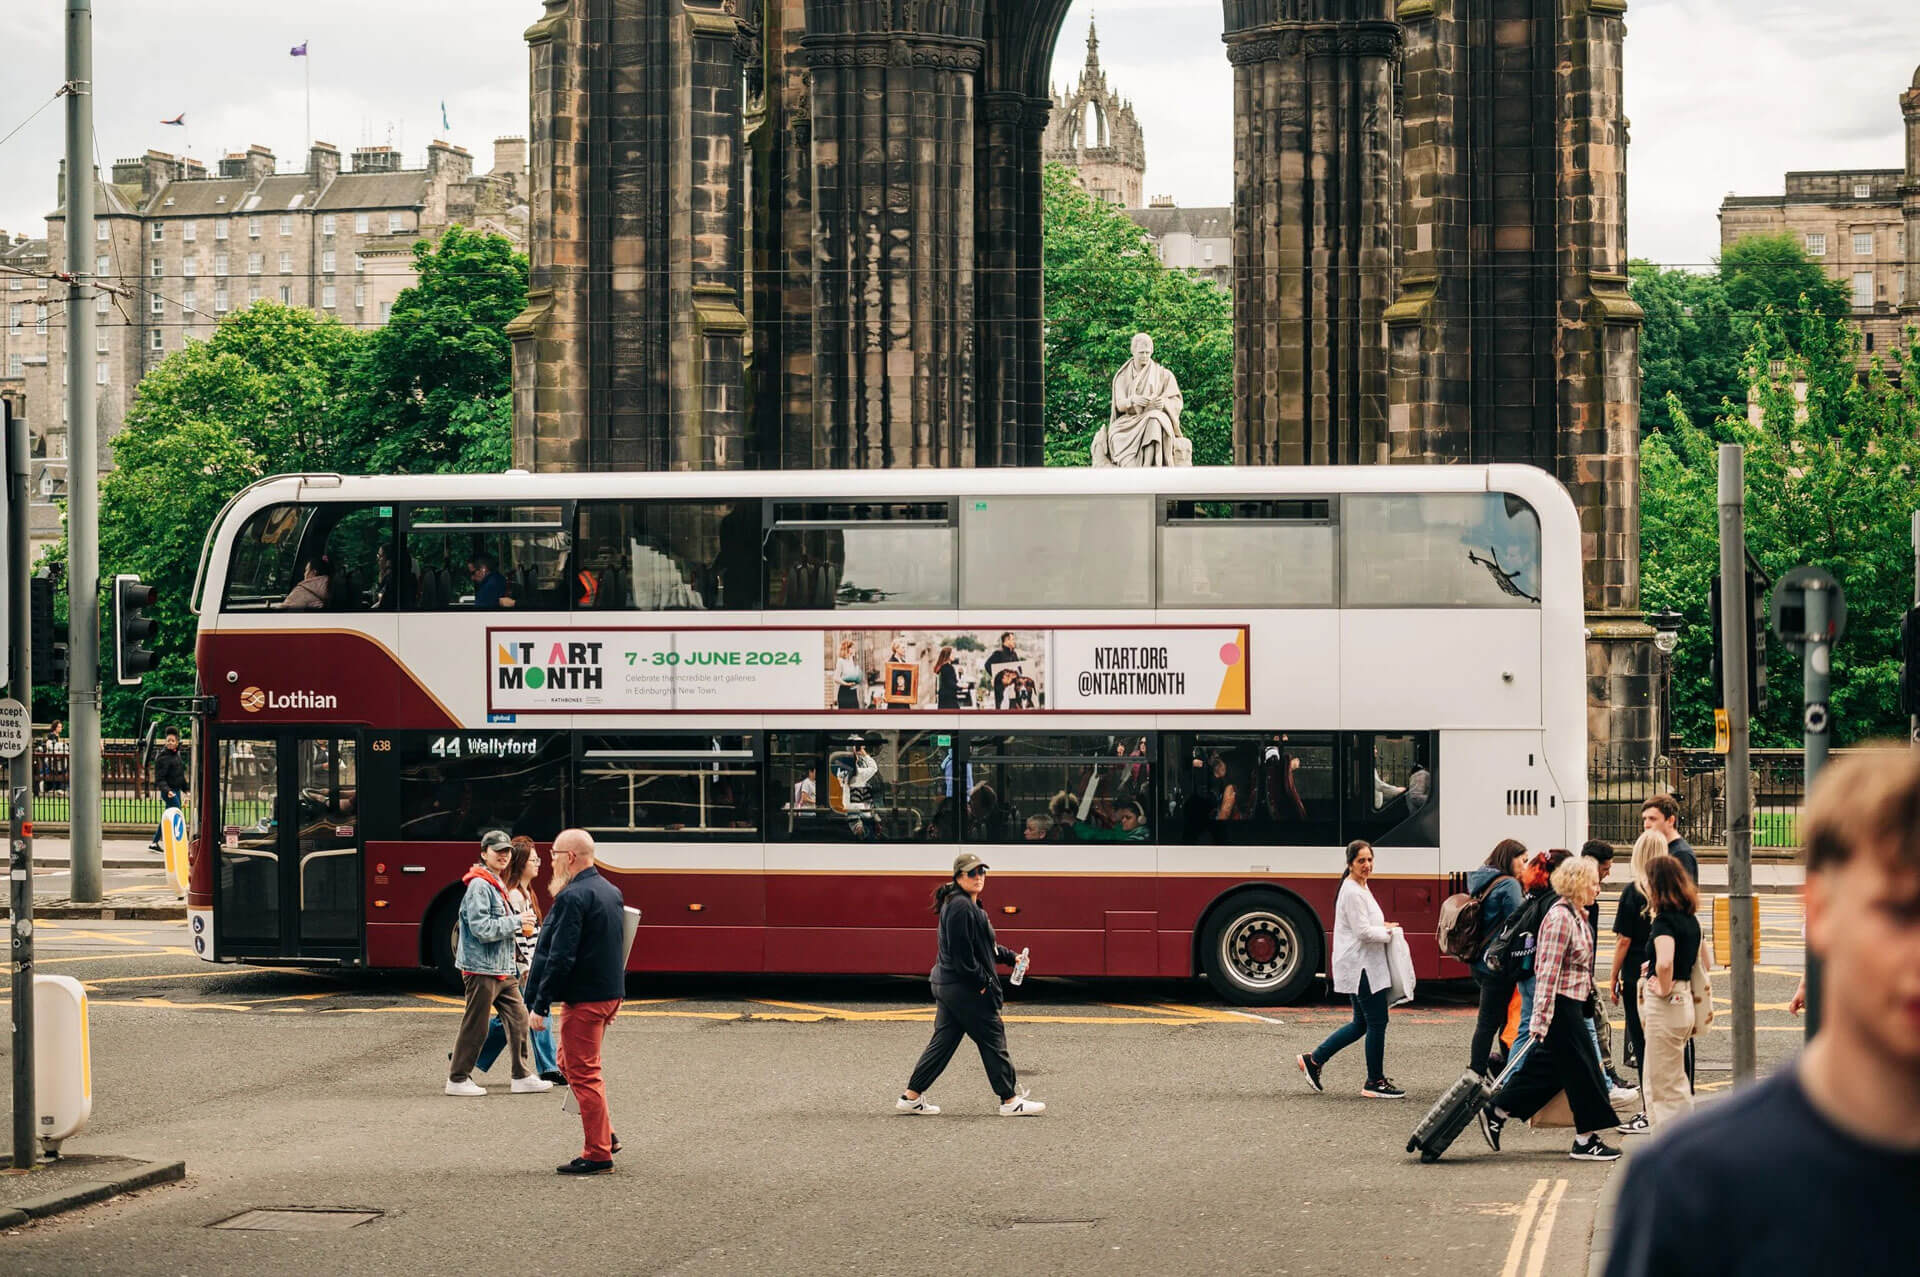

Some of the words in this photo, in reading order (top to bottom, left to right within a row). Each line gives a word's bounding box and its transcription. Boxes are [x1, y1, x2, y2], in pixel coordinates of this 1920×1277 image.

[498, 642, 535, 665] NT
[547, 642, 603, 665] ART
[624, 651, 638, 666] 7
[651, 651, 680, 666] 30
[684, 651, 741, 666] JUNE
[745, 651, 803, 666] 2024
[1095, 647, 1168, 670] NTART.ORG
[498, 666, 603, 690] MONTH
[625, 674, 661, 683] Celebrate
[713, 674, 724, 683] art
[725, 674, 757, 684] galleries
[1078, 671, 1185, 697] @NTARTMONTH
[625, 687, 633, 695] in
[678, 687, 695, 695] New
[268, 690, 338, 709] Lothian
[0, 708, 22, 717] xcept
[0, 720, 21, 728] uses,
[0, 729, 14, 739] xis
[16, 730, 22, 739] &
[0, 741, 21, 750] ycles
[372, 739, 392, 752] 638
[431, 737, 461, 758] 44
[467, 738, 537, 758] Wallyford
